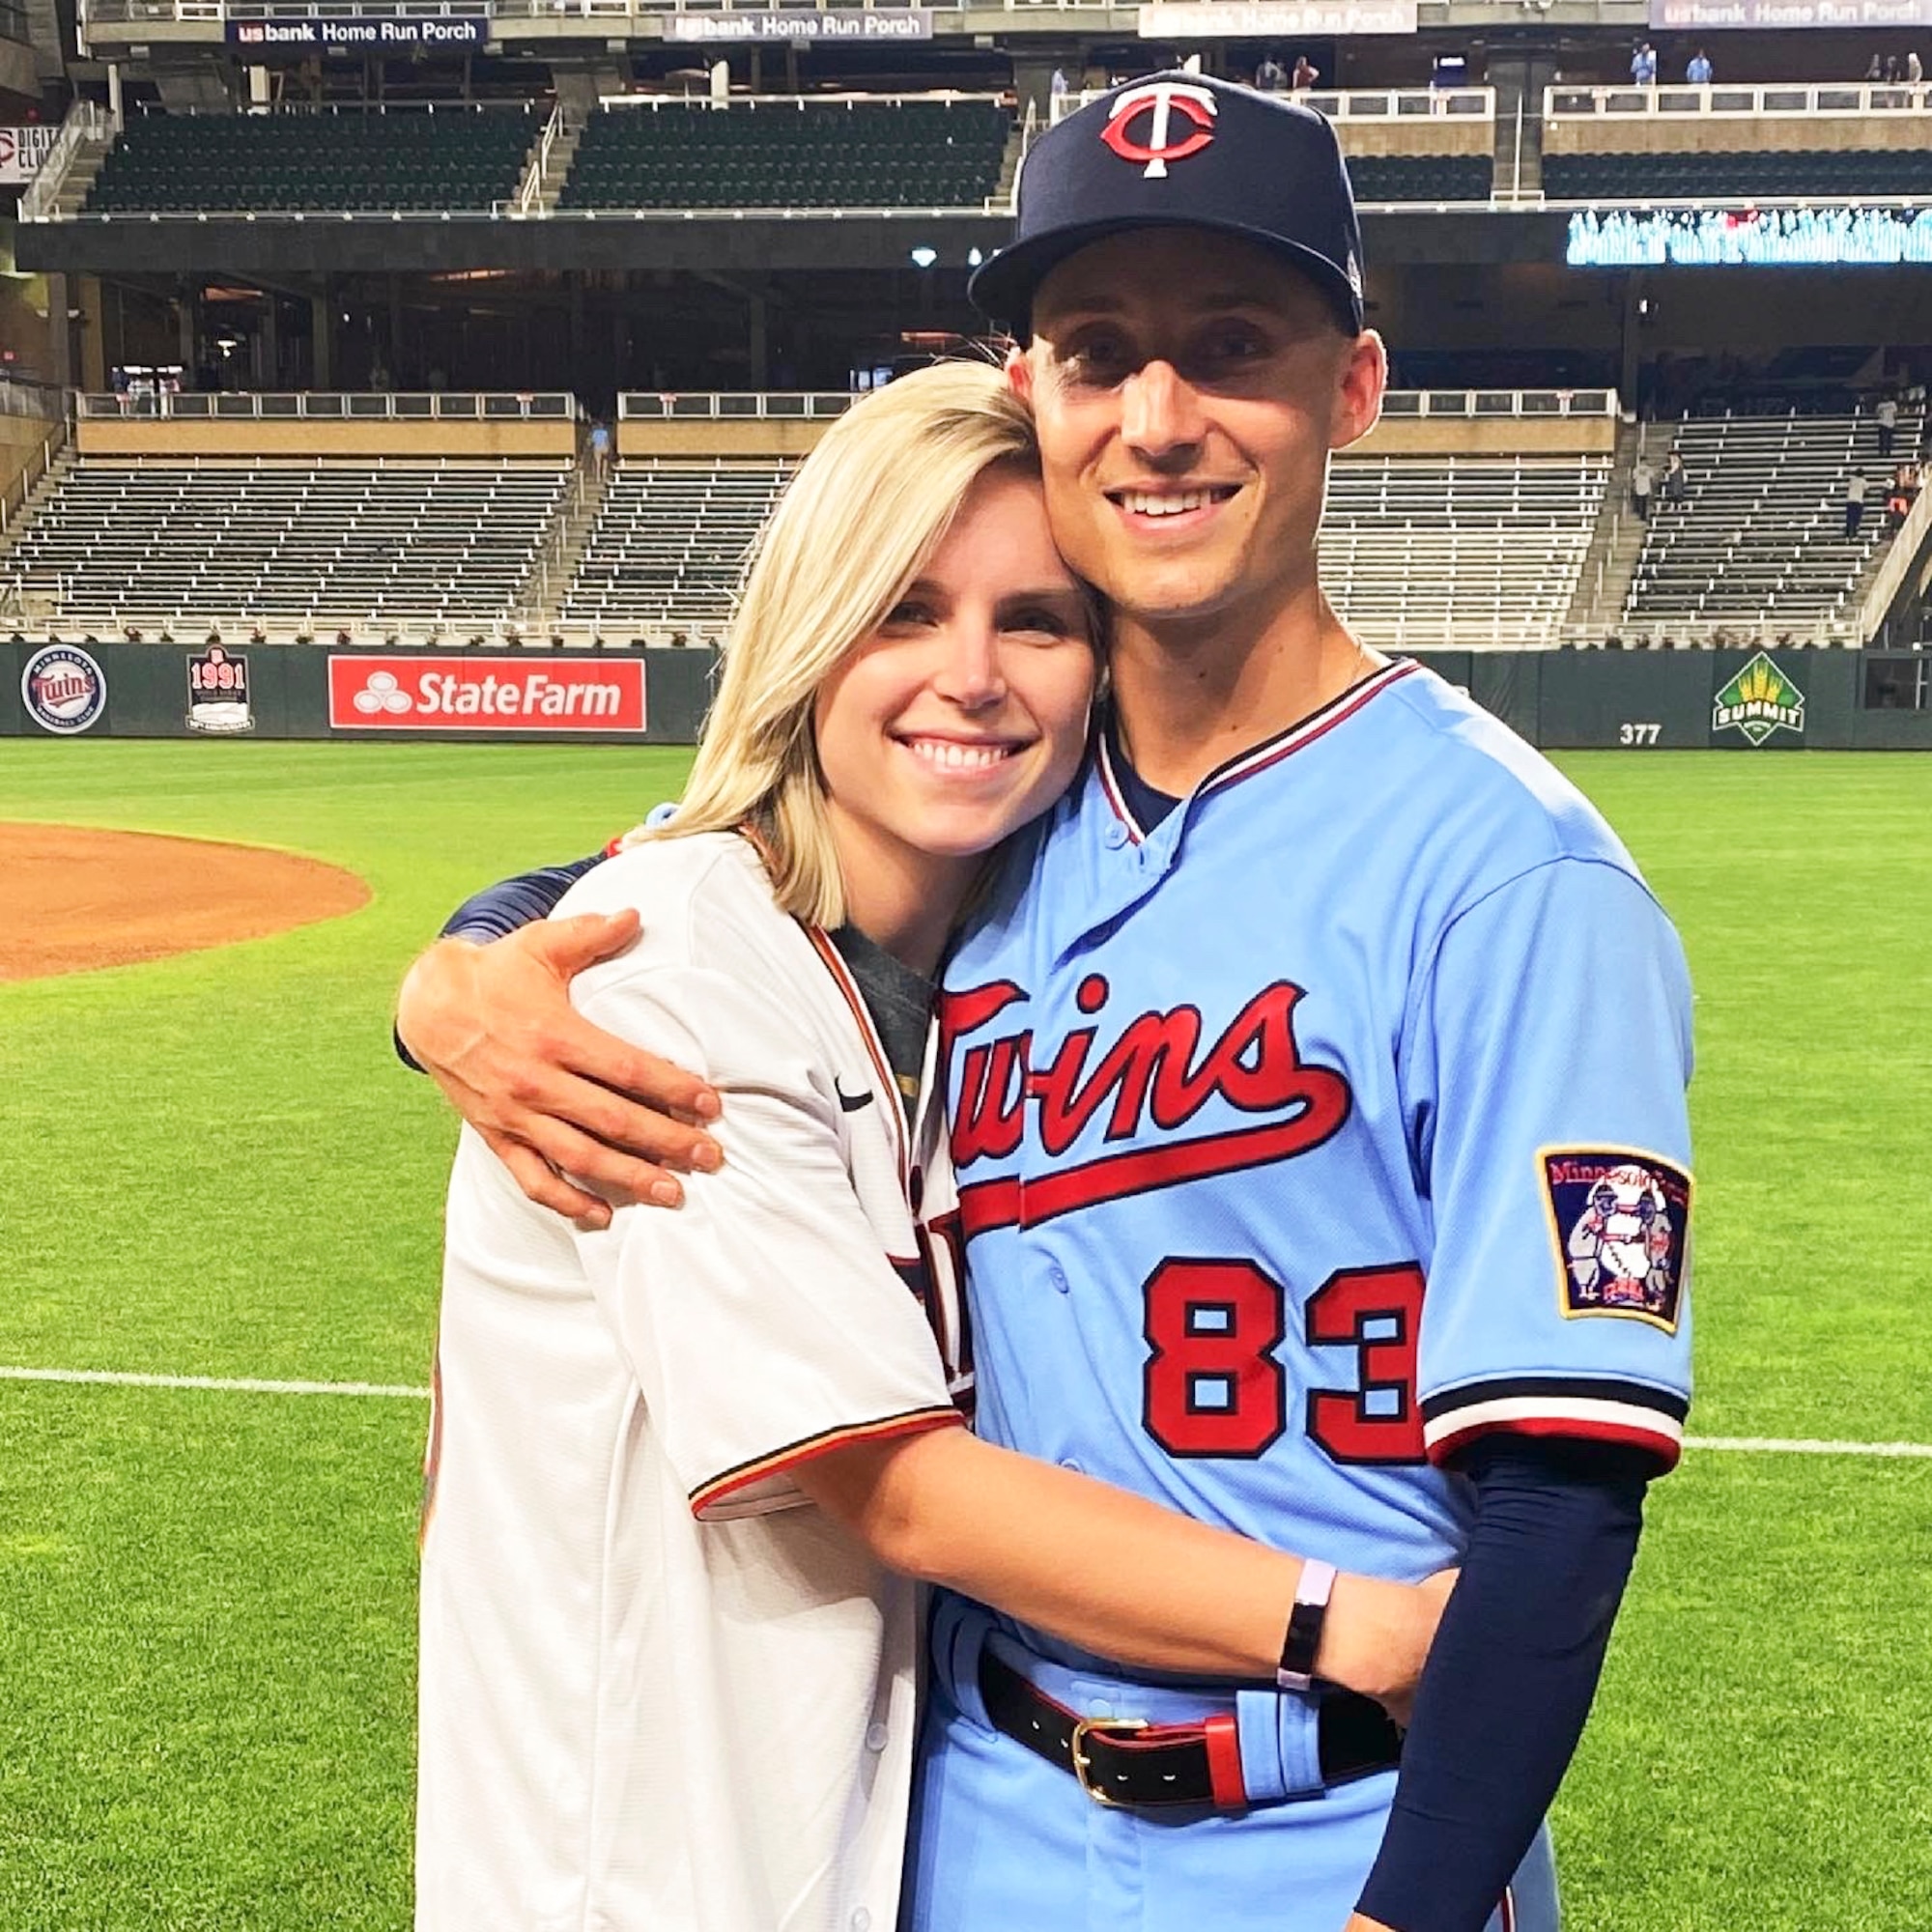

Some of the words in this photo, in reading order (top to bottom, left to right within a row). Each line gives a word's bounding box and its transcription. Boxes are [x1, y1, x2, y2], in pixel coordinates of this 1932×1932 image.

[1754, 4, 1813, 22] Home
[1818, 3, 1858, 21] Run
[322, 22, 377, 42] Home
[381, 22, 418, 41] Run
[422, 21, 476, 41] Porch
[761, 16, 818, 36] Home
[823, 16, 860, 35] Run
[864, 15, 920, 35] Porch
[191, 662, 245, 690] 1991
[32, 673, 96, 708] Twins
[1718, 699, 1801, 724] SUMMIT
[1620, 724, 1662, 746] 377
[942, 974, 1354, 1232] Twins
[1141, 1256, 1426, 1466] 83
